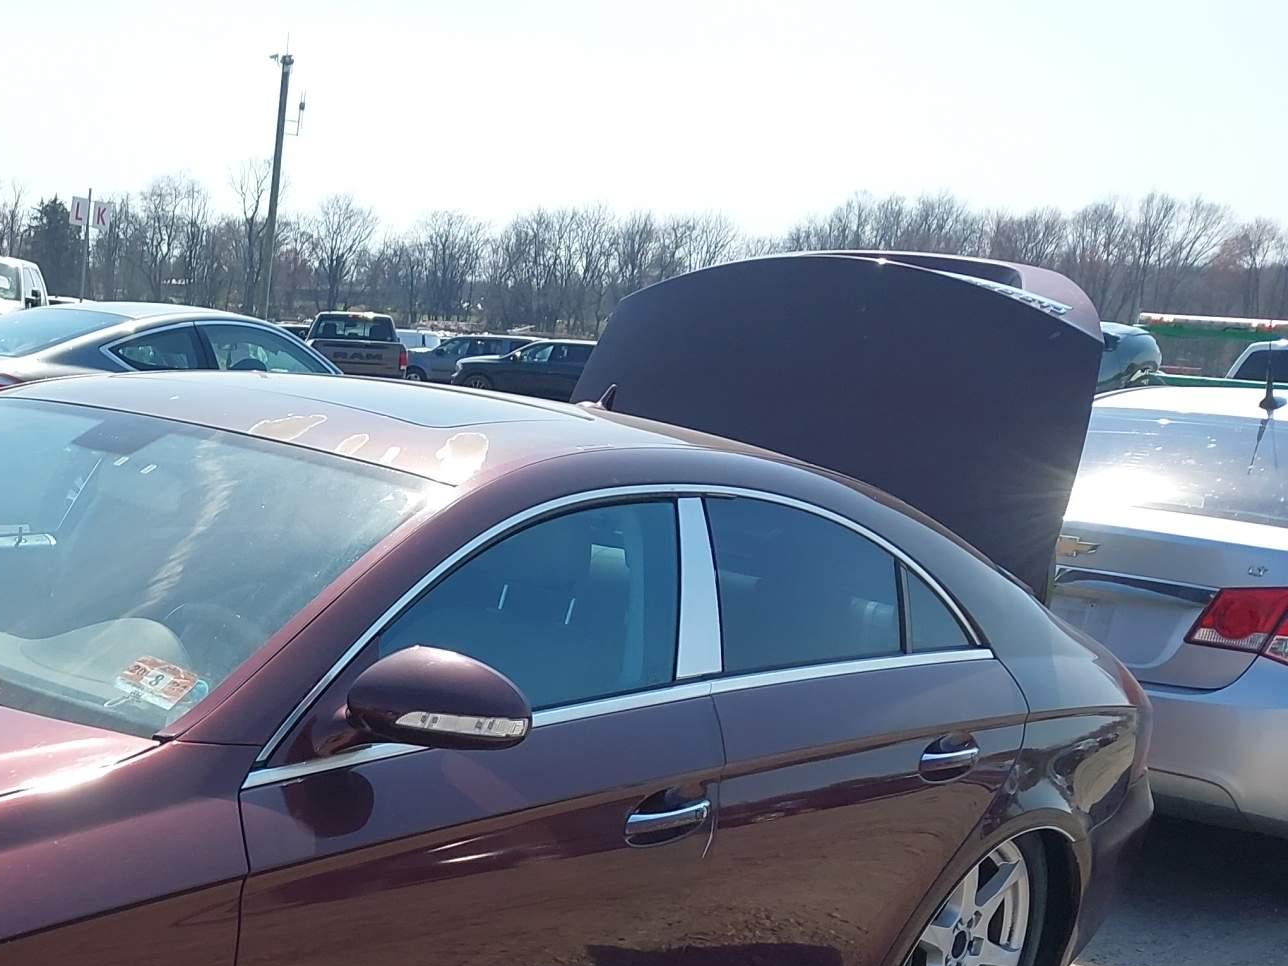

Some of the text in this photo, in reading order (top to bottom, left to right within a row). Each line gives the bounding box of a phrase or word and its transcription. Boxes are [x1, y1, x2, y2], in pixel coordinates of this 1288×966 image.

[75, 201, 83, 221] L
[96, 206, 107, 226] K
[332, 351, 384, 361] RAM
[149, 674, 164, 687] 8
